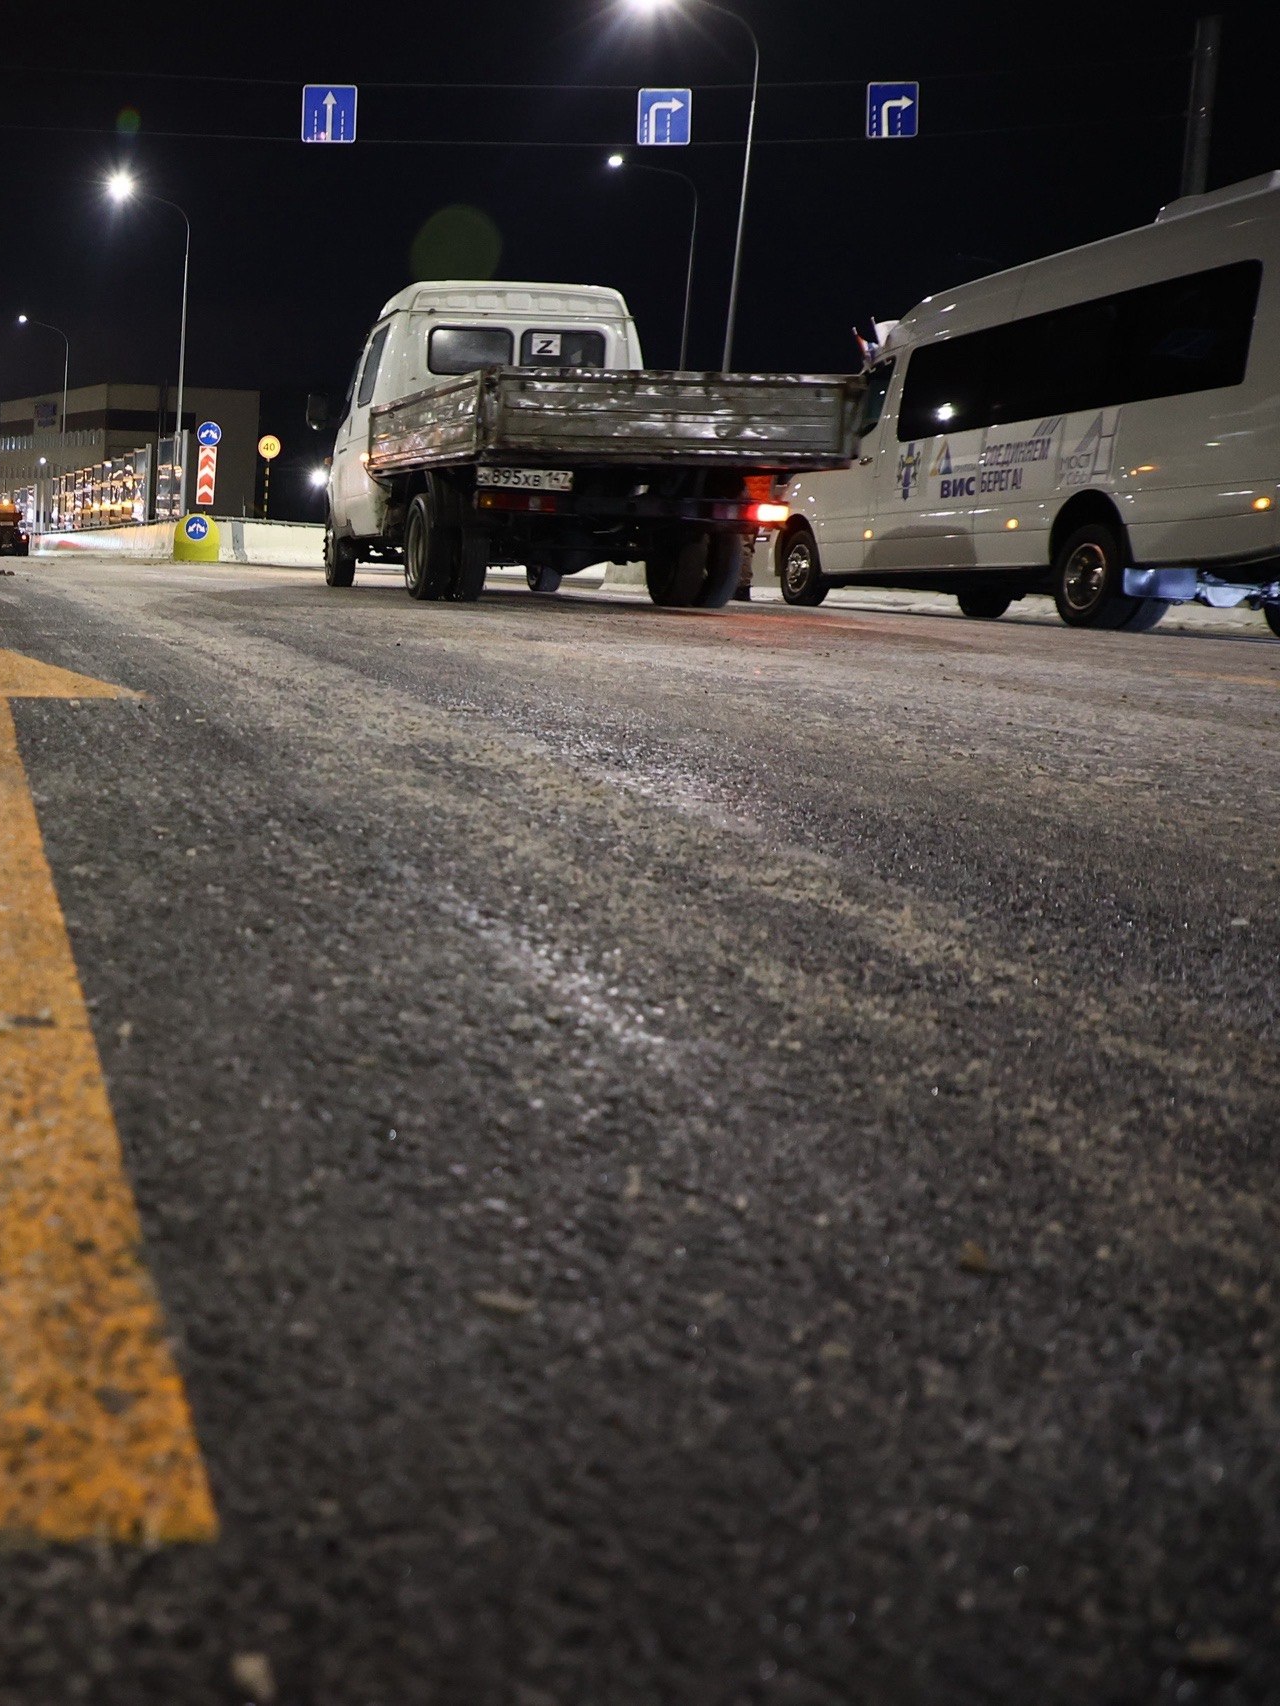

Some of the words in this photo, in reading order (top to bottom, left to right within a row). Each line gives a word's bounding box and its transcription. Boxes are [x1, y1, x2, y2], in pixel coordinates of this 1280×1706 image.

[536, 340, 554, 354] Z
[263, 443, 276, 452] 40
[940, 477, 976, 498] ВИС
[980, 467, 1023, 493] БЕРЕГА!
